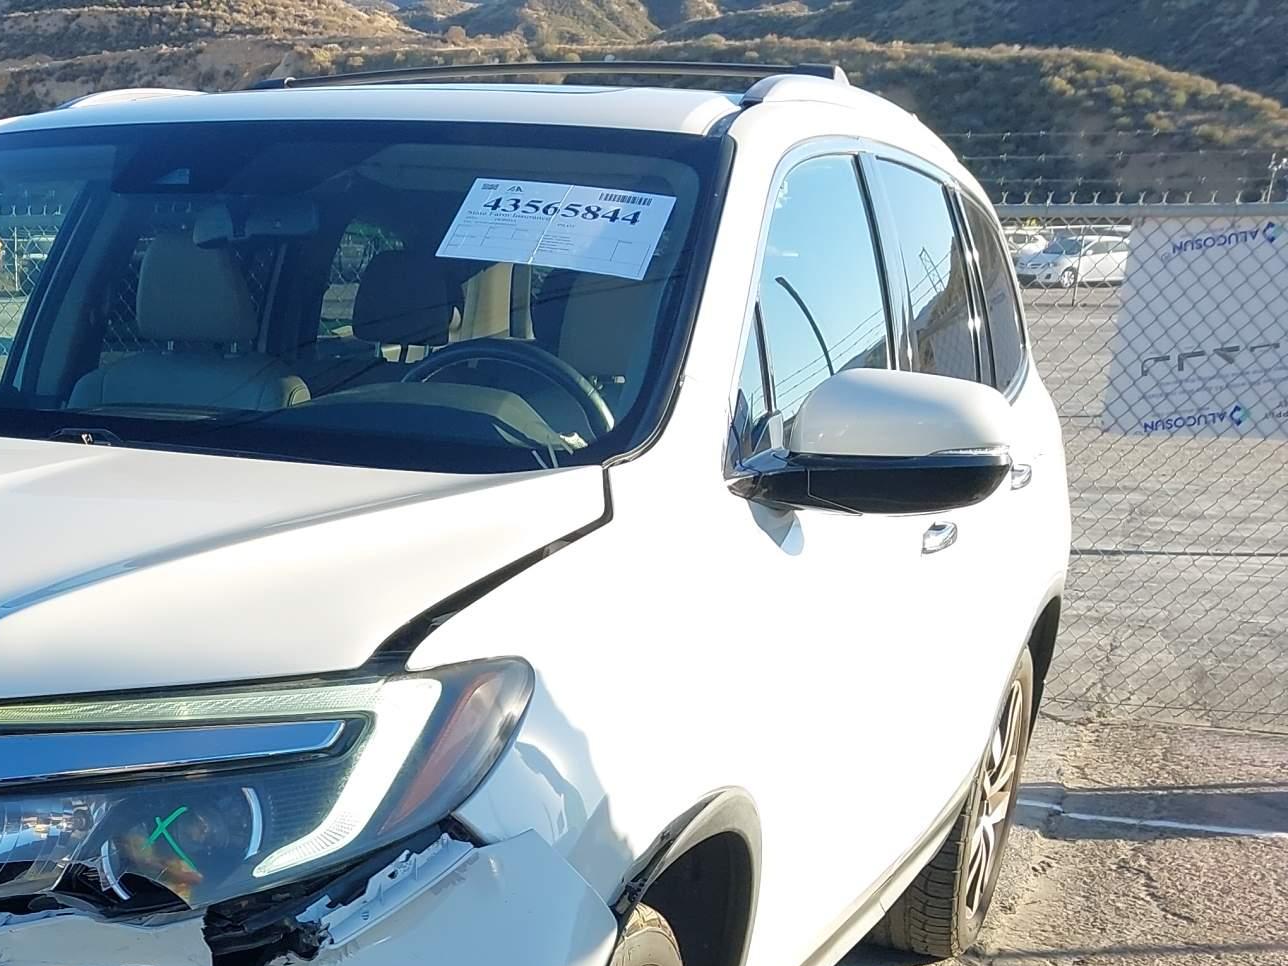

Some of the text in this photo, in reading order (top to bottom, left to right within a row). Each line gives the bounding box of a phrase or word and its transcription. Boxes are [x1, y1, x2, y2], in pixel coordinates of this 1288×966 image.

[483, 196, 640, 226] 43565844
[1172, 227, 1259, 254] ALUCOSUN
[1143, 410, 1228, 433] ALUCOSUN
